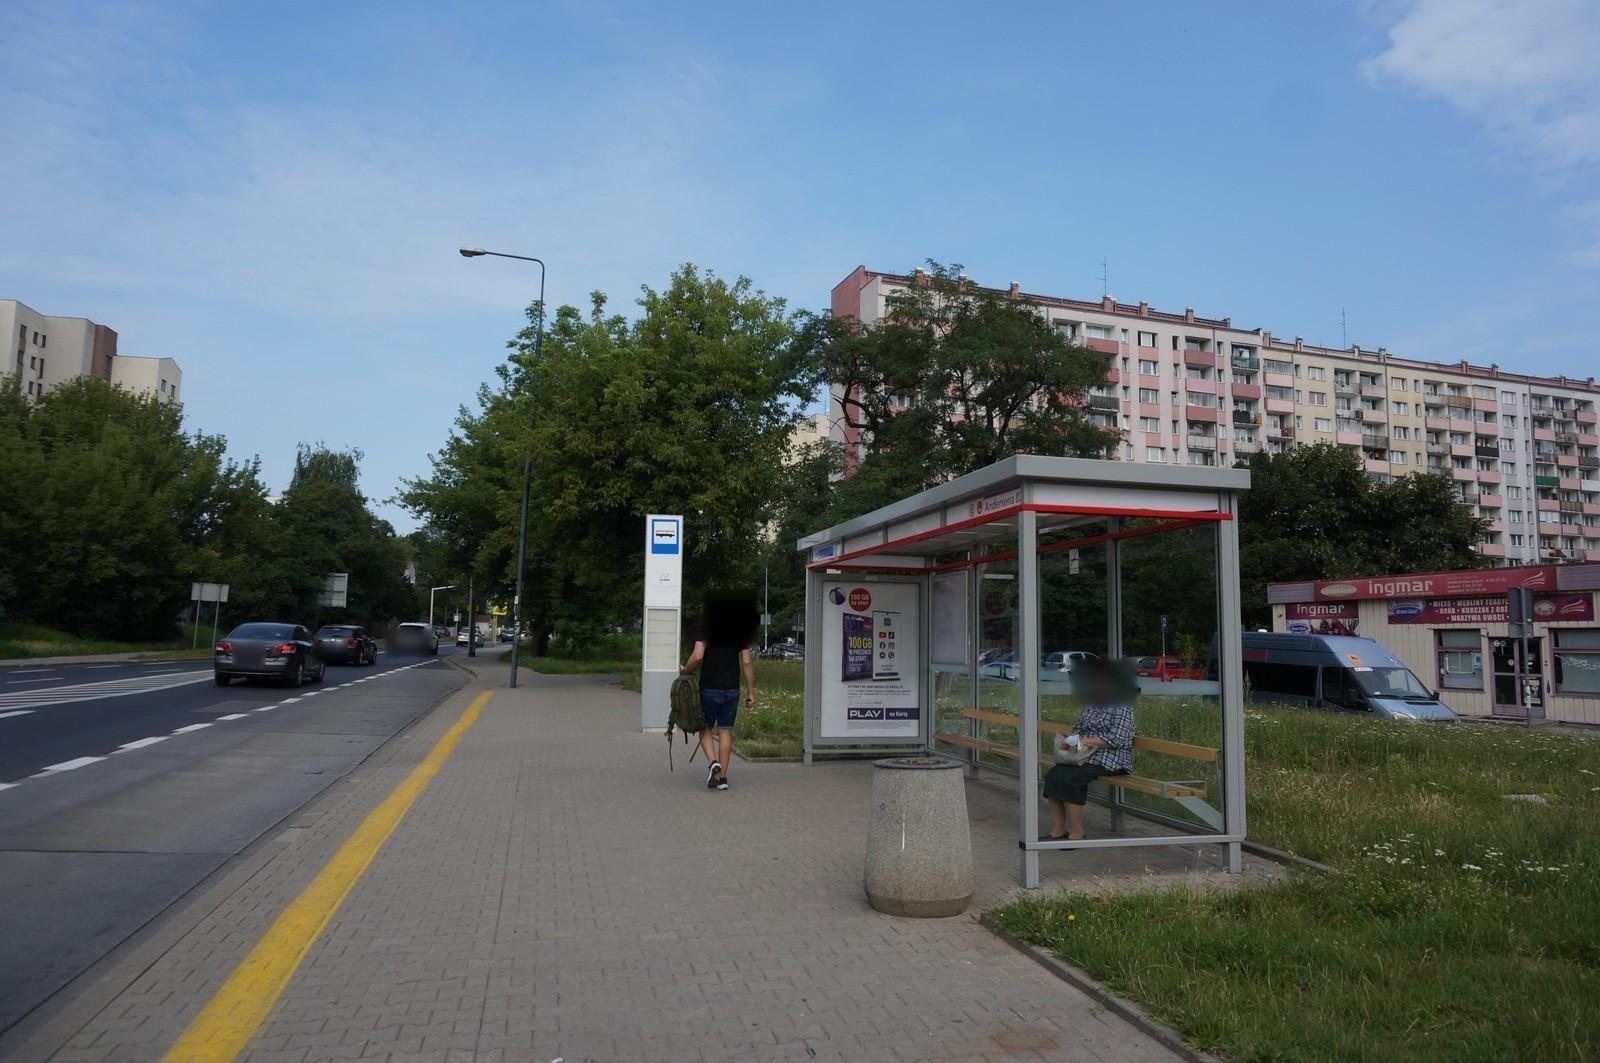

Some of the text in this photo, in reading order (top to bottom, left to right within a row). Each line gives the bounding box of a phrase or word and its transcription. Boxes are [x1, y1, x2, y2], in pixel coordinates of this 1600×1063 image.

[1368, 580, 1433, 597] ingmar
[1297, 604, 1344, 616] ingmar
[848, 637, 873, 649] 100 GB
[849, 710, 881, 718] PLAY
